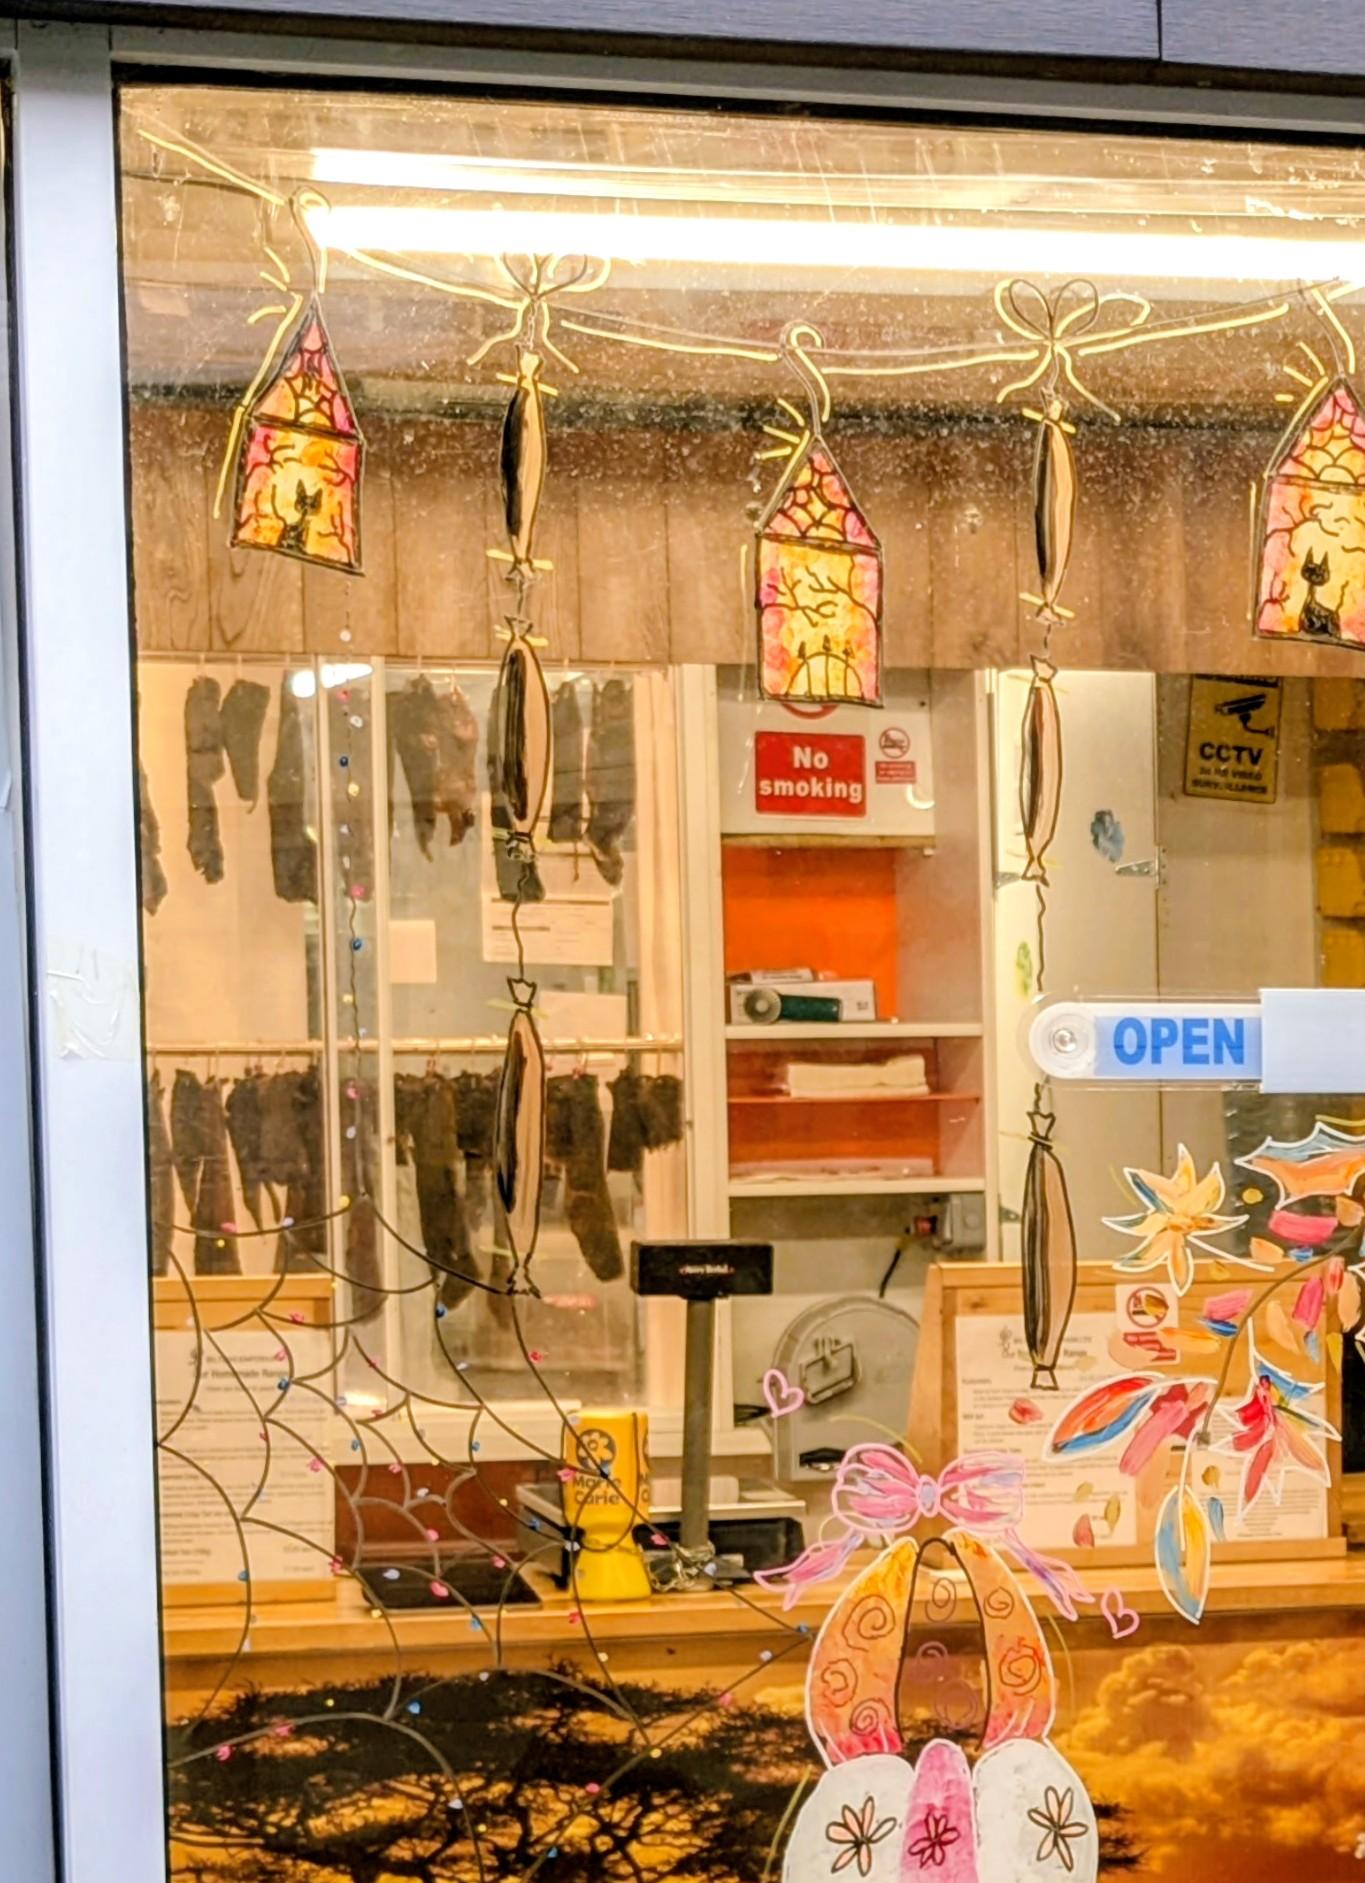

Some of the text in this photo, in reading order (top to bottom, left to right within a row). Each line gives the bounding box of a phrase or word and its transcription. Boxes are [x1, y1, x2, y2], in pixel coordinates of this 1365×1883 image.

[793, 746, 829, 769] No
[1199, 742, 1263, 766] CCTV
[759, 777, 863, 804] smoking
[1113, 1017, 1245, 1066] OPEN
